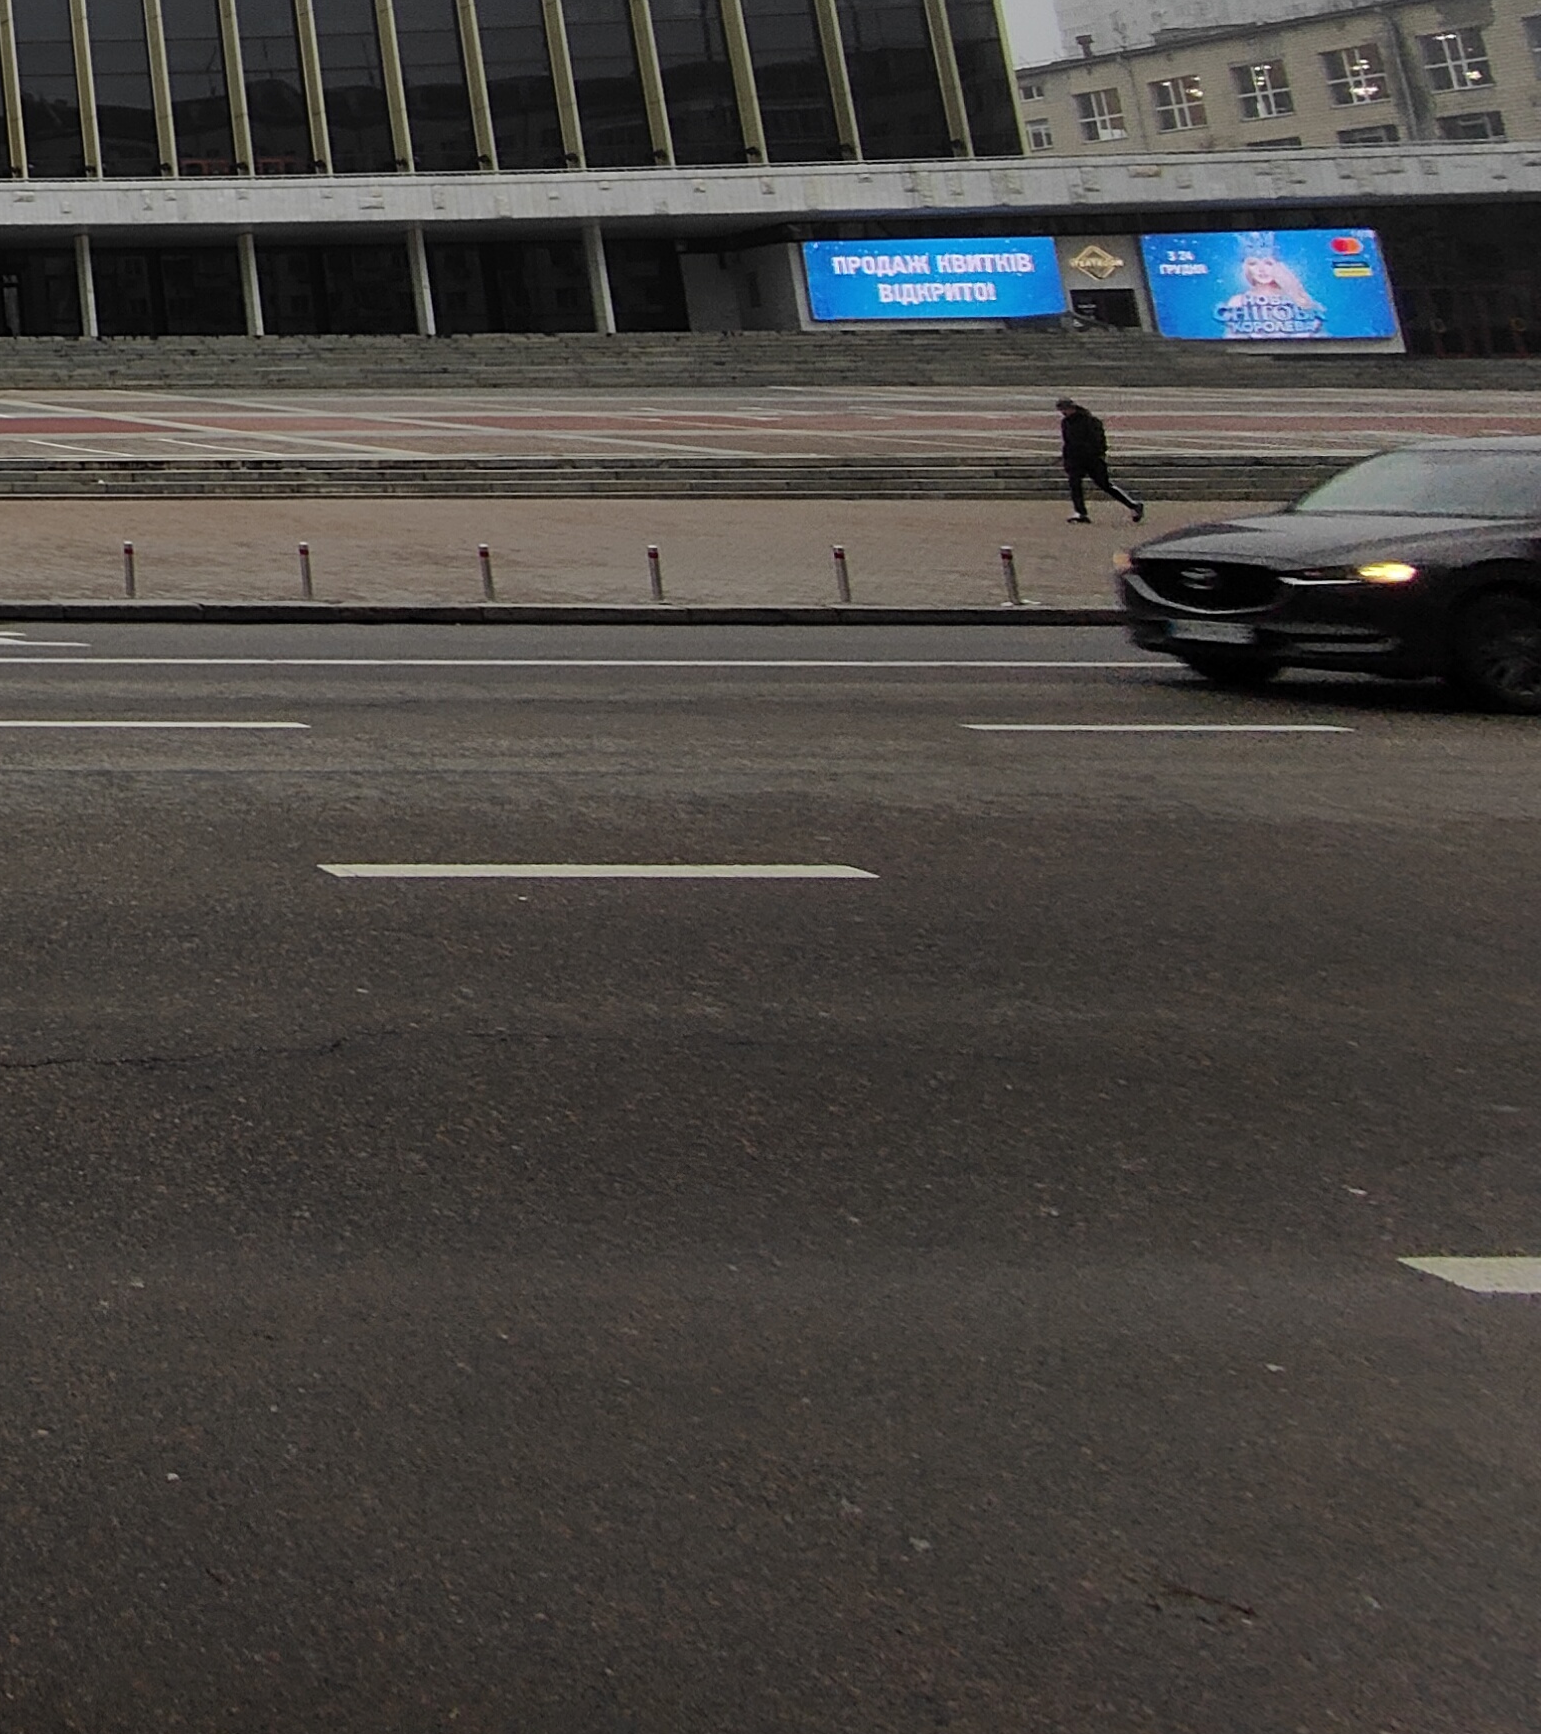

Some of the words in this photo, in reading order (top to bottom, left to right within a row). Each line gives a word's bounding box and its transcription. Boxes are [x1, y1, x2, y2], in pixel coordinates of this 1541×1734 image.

[832, 254, 931, 277] ПРОДАЖ
[937, 252, 1035, 273] КВИТКІВ
[878, 282, 996, 305] ВІДКРИТО!
